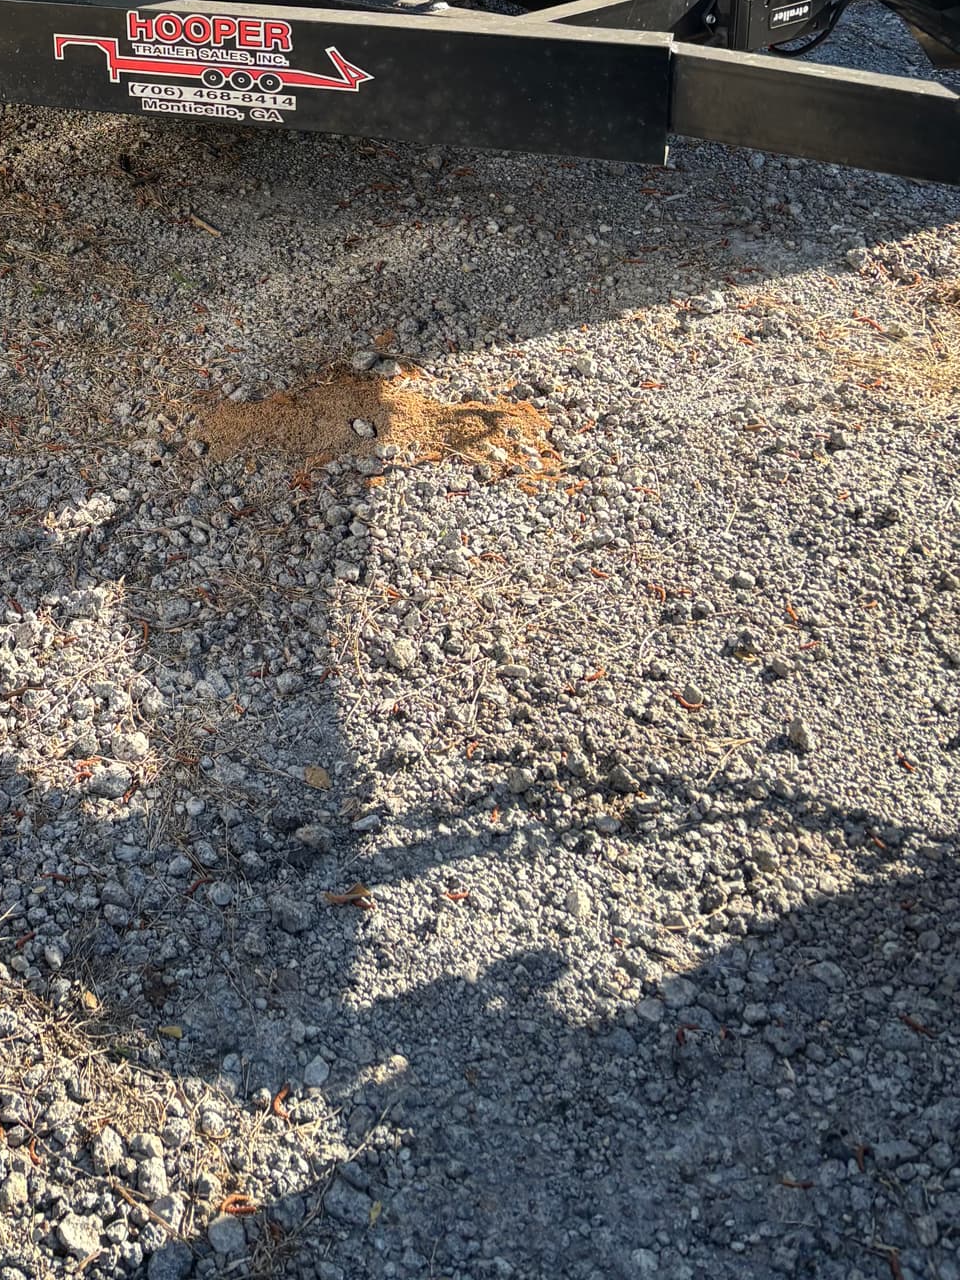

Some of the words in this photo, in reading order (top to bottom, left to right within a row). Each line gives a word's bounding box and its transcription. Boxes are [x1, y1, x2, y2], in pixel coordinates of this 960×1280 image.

[773, 5, 809, 21] etrailer
[128, 11, 292, 51] HOOPER
[134, 44, 197, 58] TRAILER
[199, 49, 254, 64] SALES,
[257, 53, 289, 66] INC.
[130, 85, 184, 99] (706)
[193, 90, 294, 106] 468-8414
[143, 99, 244, 120] Monticello,
[250, 109, 283, 122] GA
